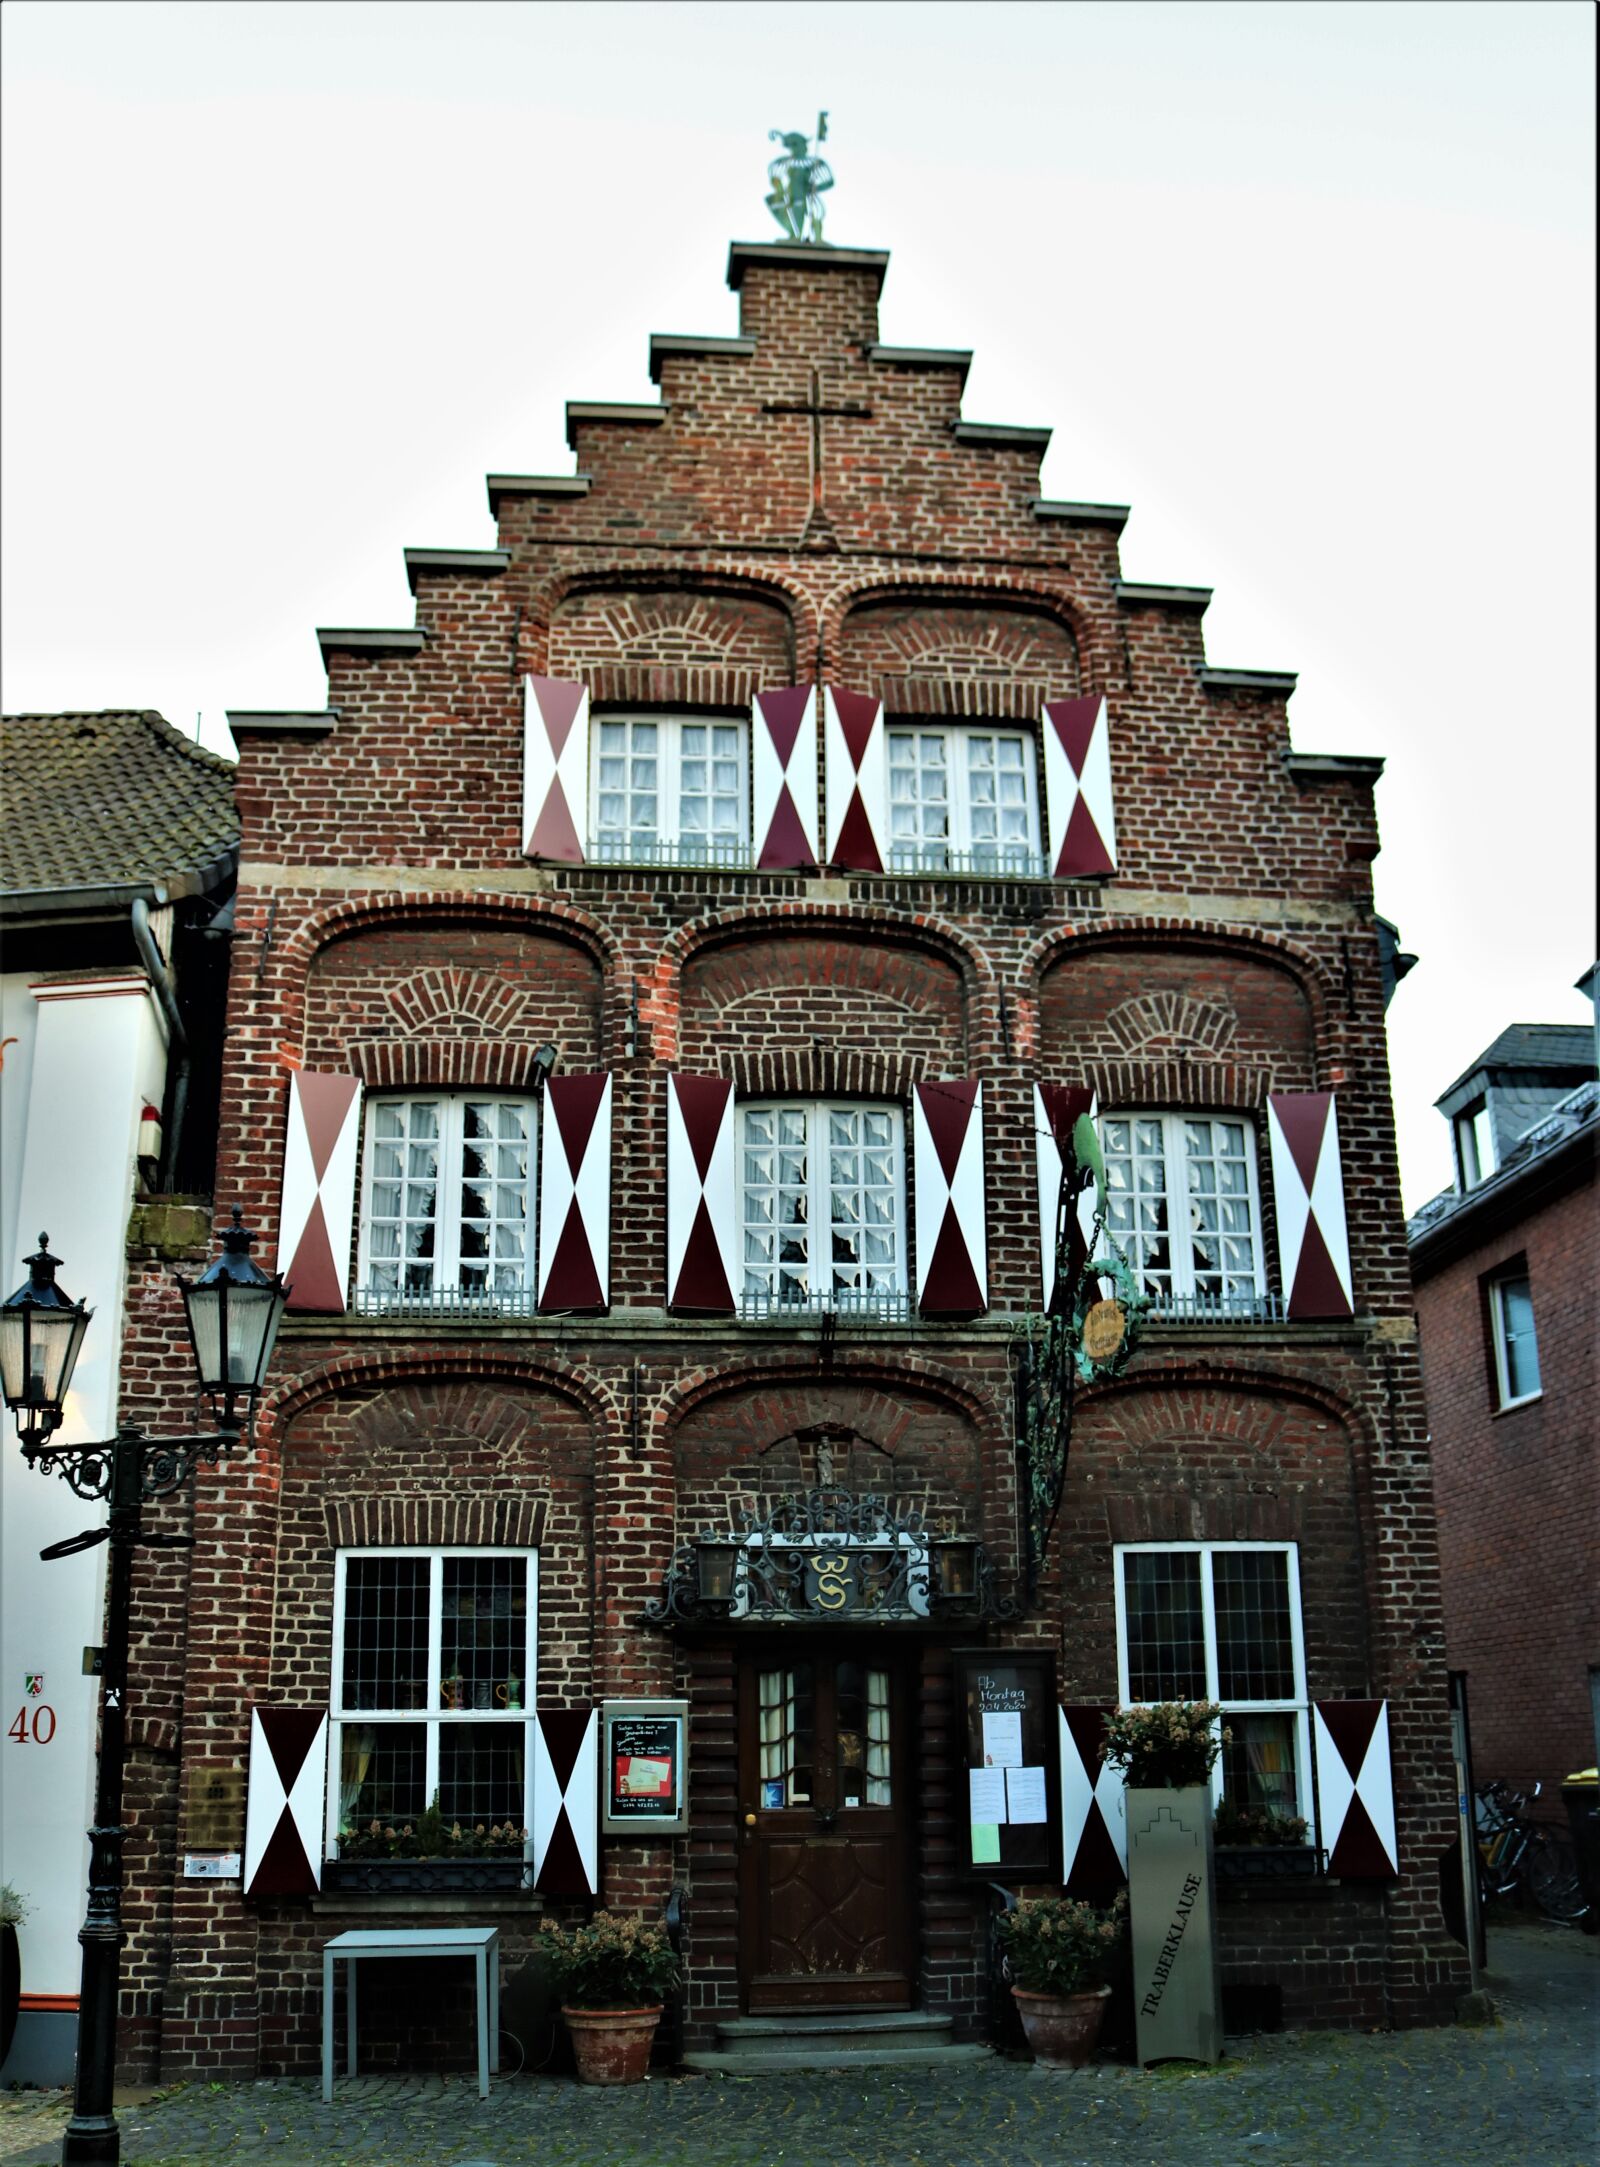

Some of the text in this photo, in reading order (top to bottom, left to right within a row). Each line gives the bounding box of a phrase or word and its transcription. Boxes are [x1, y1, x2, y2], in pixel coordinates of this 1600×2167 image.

[981, 1688, 1025, 1702] Montag
[8, 1705, 56, 1744] 40
[1141, 1873, 1202, 2017] TRABERKLAUSE
